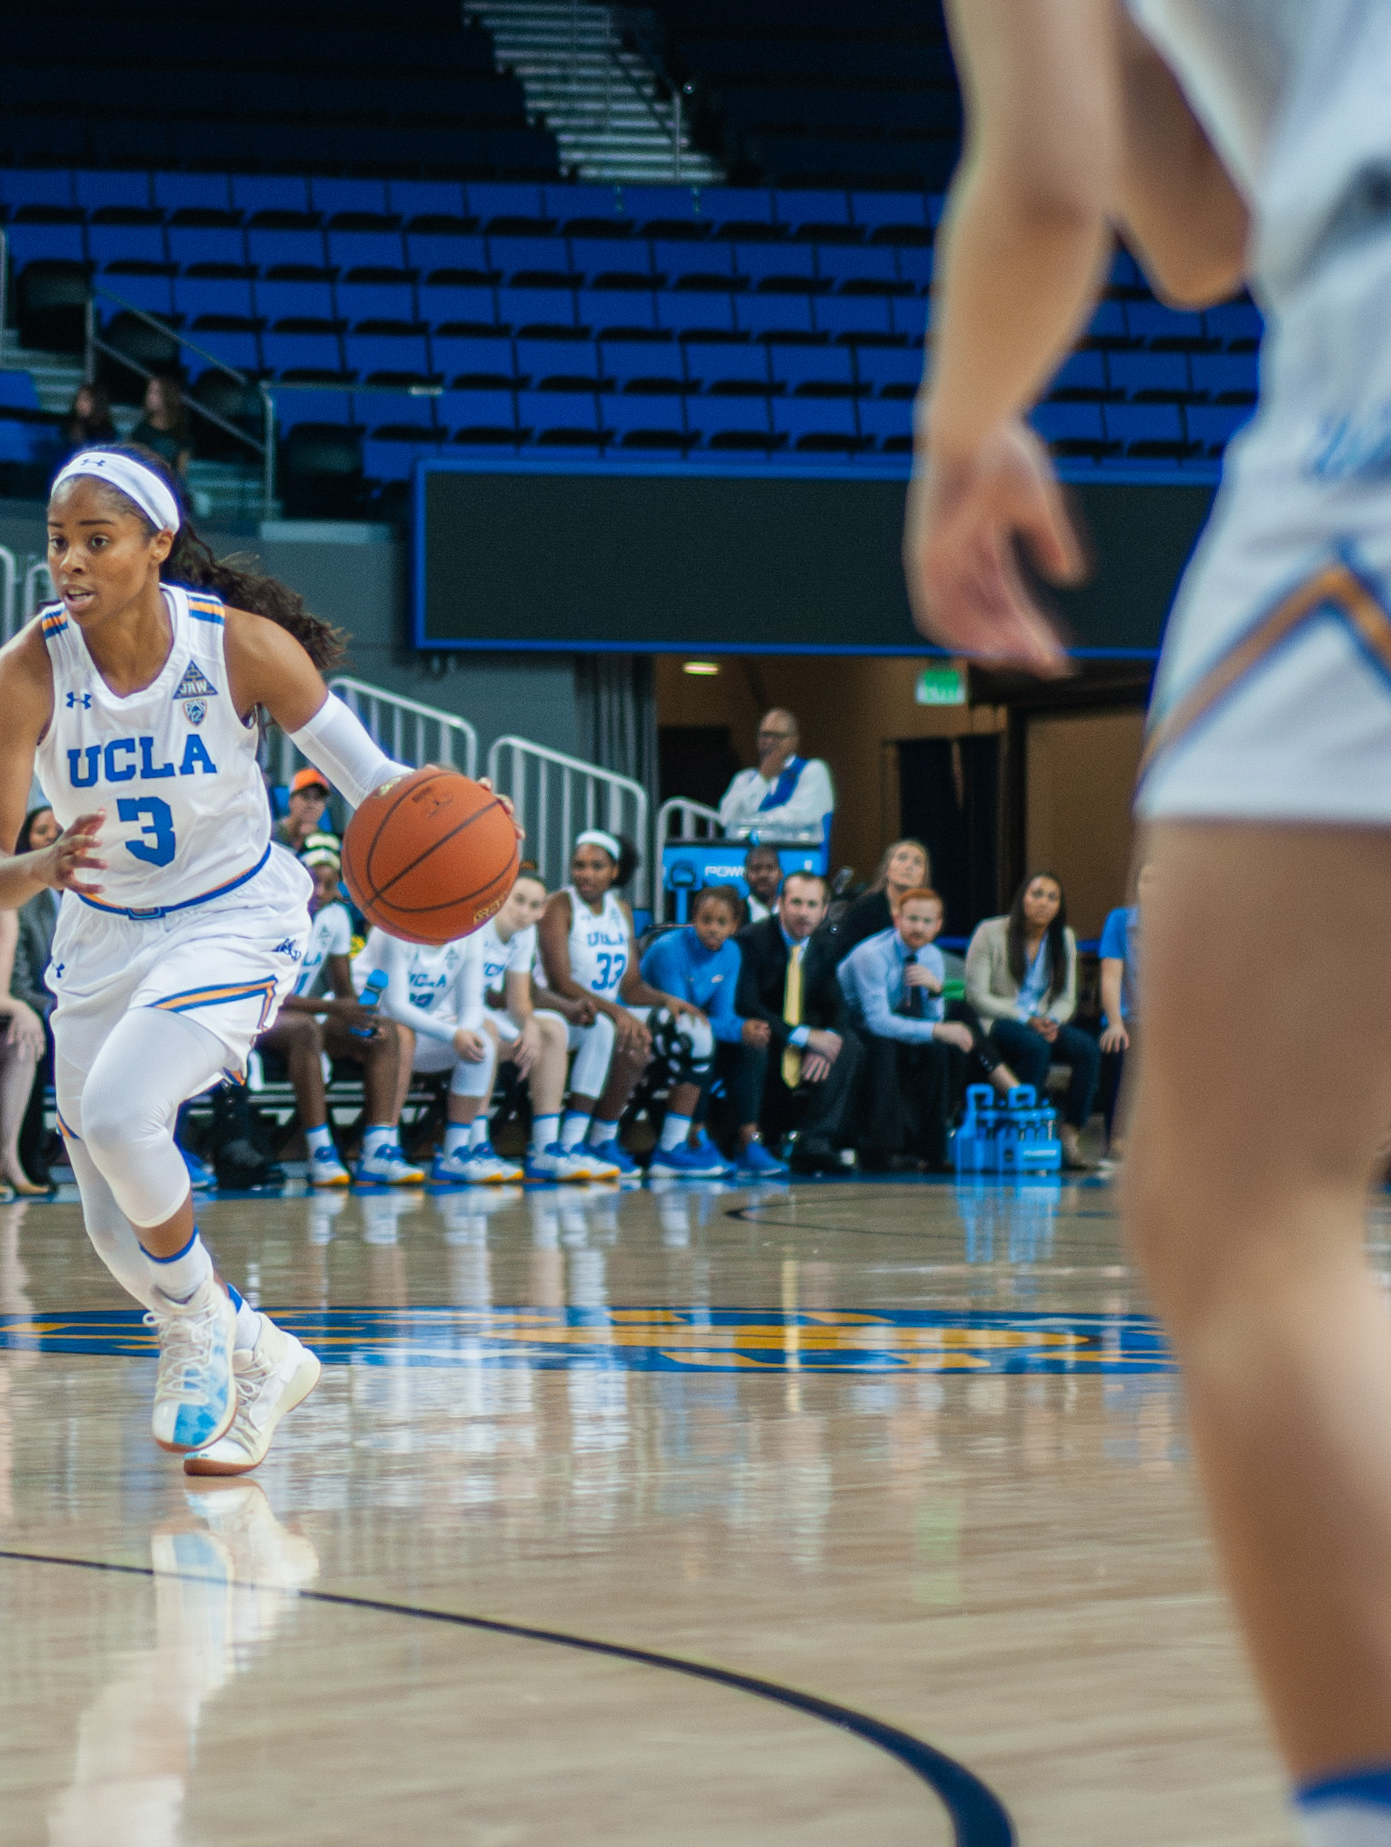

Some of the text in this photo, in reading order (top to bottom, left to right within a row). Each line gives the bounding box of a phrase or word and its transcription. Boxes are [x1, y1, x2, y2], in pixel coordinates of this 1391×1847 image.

[179, 680, 208, 695] JRW
[67, 734, 218, 788] UCLA
[116, 796, 176, 868] 3
